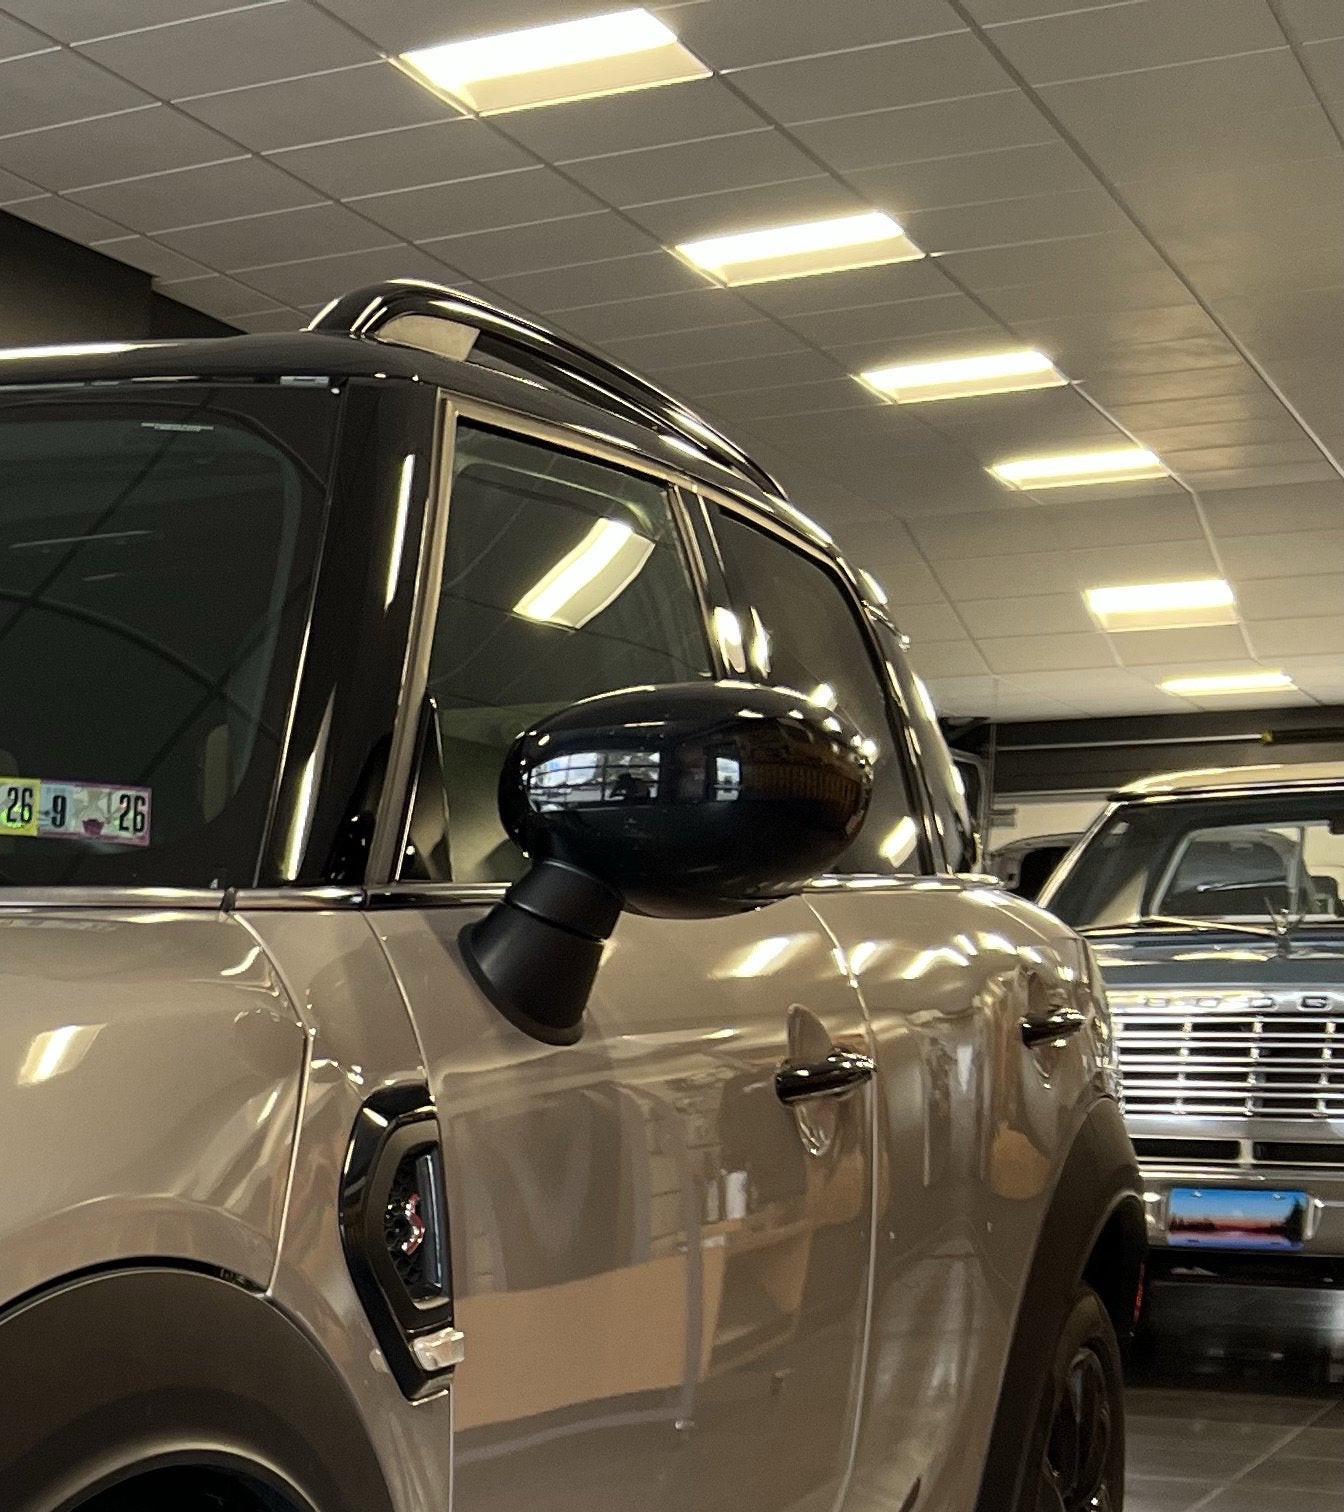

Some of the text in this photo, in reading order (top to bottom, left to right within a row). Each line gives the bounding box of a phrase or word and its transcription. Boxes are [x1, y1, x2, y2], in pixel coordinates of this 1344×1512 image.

[6, 787, 33, 824] 26
[51, 794, 146, 832] 9 26
